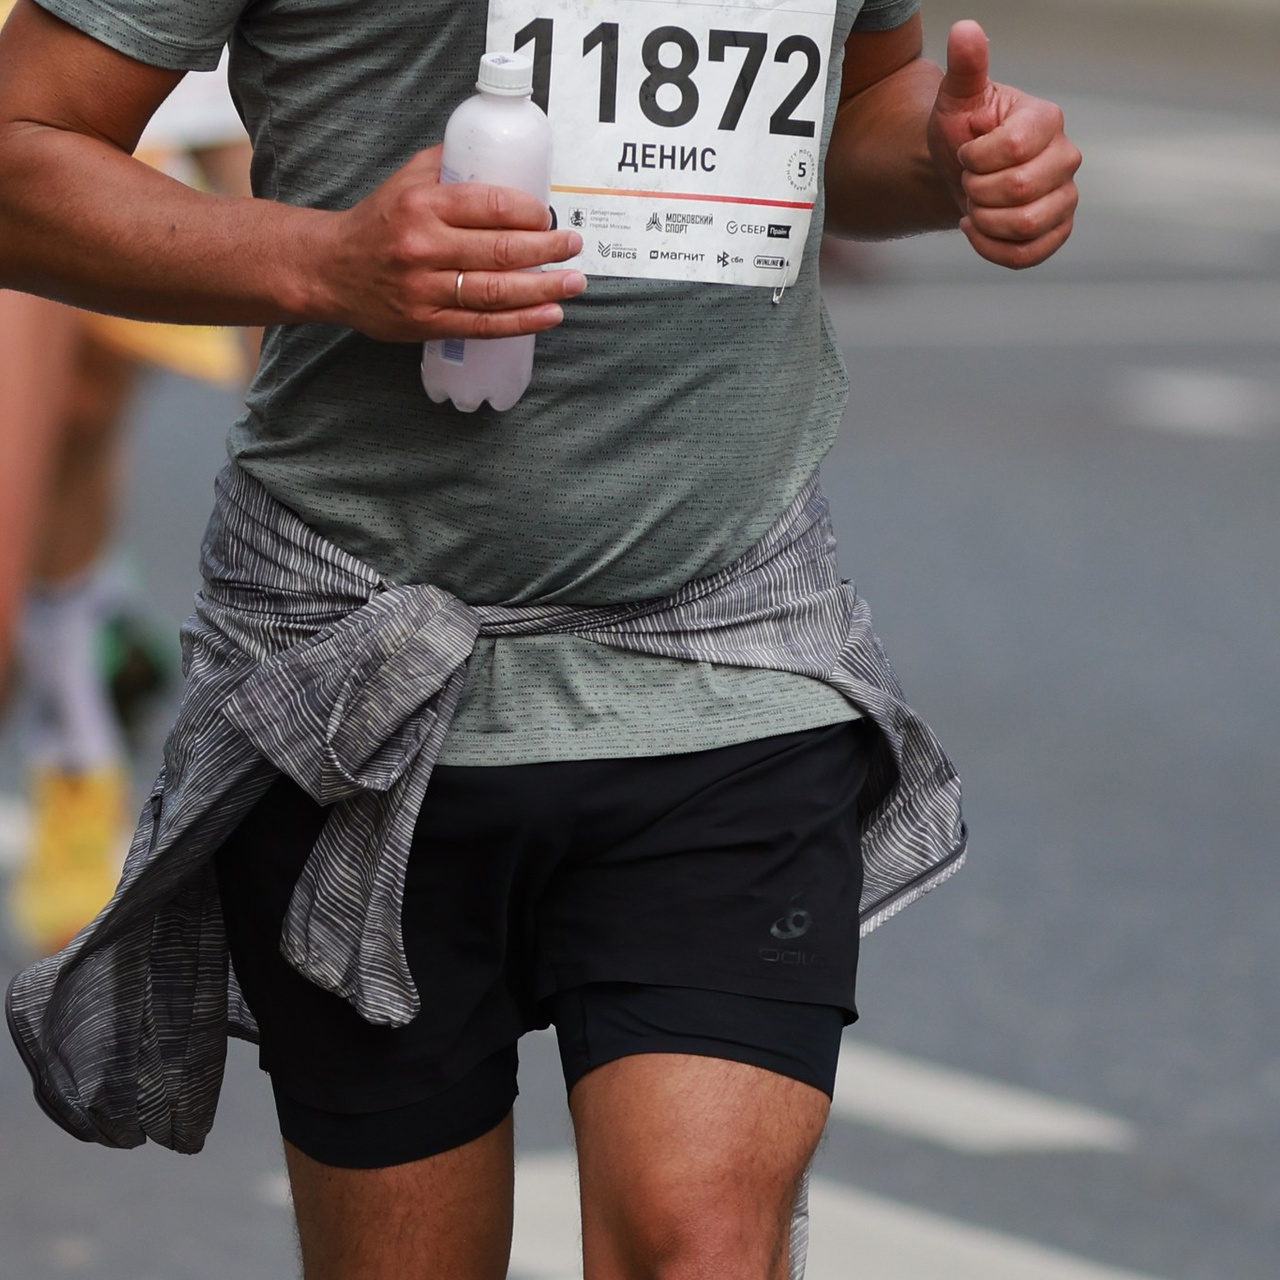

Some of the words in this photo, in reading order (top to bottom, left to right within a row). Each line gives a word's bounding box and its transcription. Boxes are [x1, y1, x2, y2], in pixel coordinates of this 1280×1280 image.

[513, 17, 821, 138] 11872
[617, 142, 717, 173] ДЕНИС
[797, 161, 807, 178] 5
[665, 212, 714, 225] МОСКОВСКИЙ
[664, 223, 689, 234] СПОРТ
[740, 223, 766, 235] СБЕР
[611, 250, 637, 260] BRICS
[756, 258, 780, 267] WINLINE
